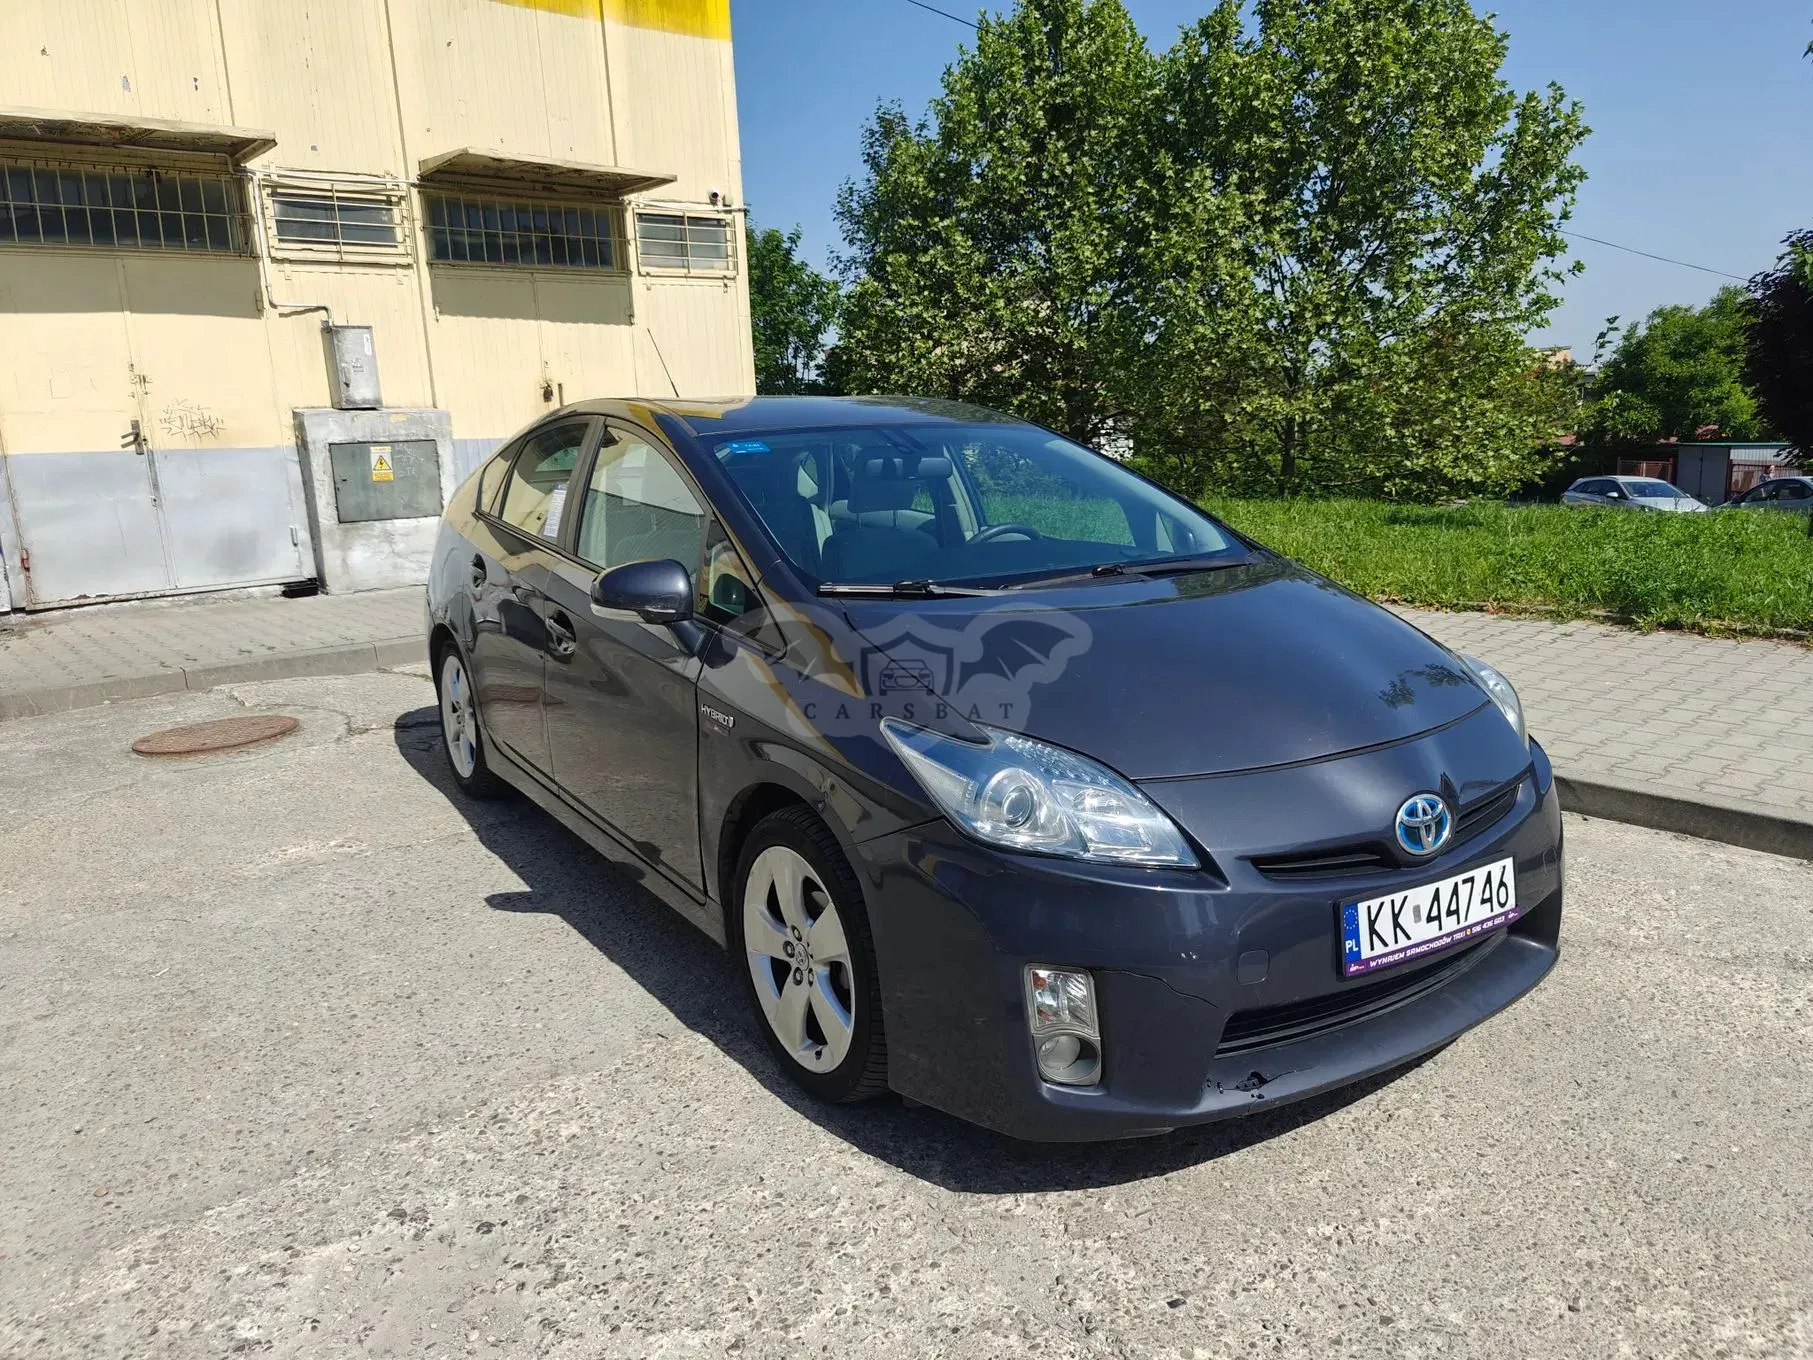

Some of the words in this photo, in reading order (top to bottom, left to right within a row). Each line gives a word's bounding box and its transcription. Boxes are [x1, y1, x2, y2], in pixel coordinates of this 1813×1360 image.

[701, 703, 728, 725] HYBRID
[1366, 895, 1412, 952] KK
[1425, 865, 1509, 932] 44746
[1345, 939, 1359, 953] PL
